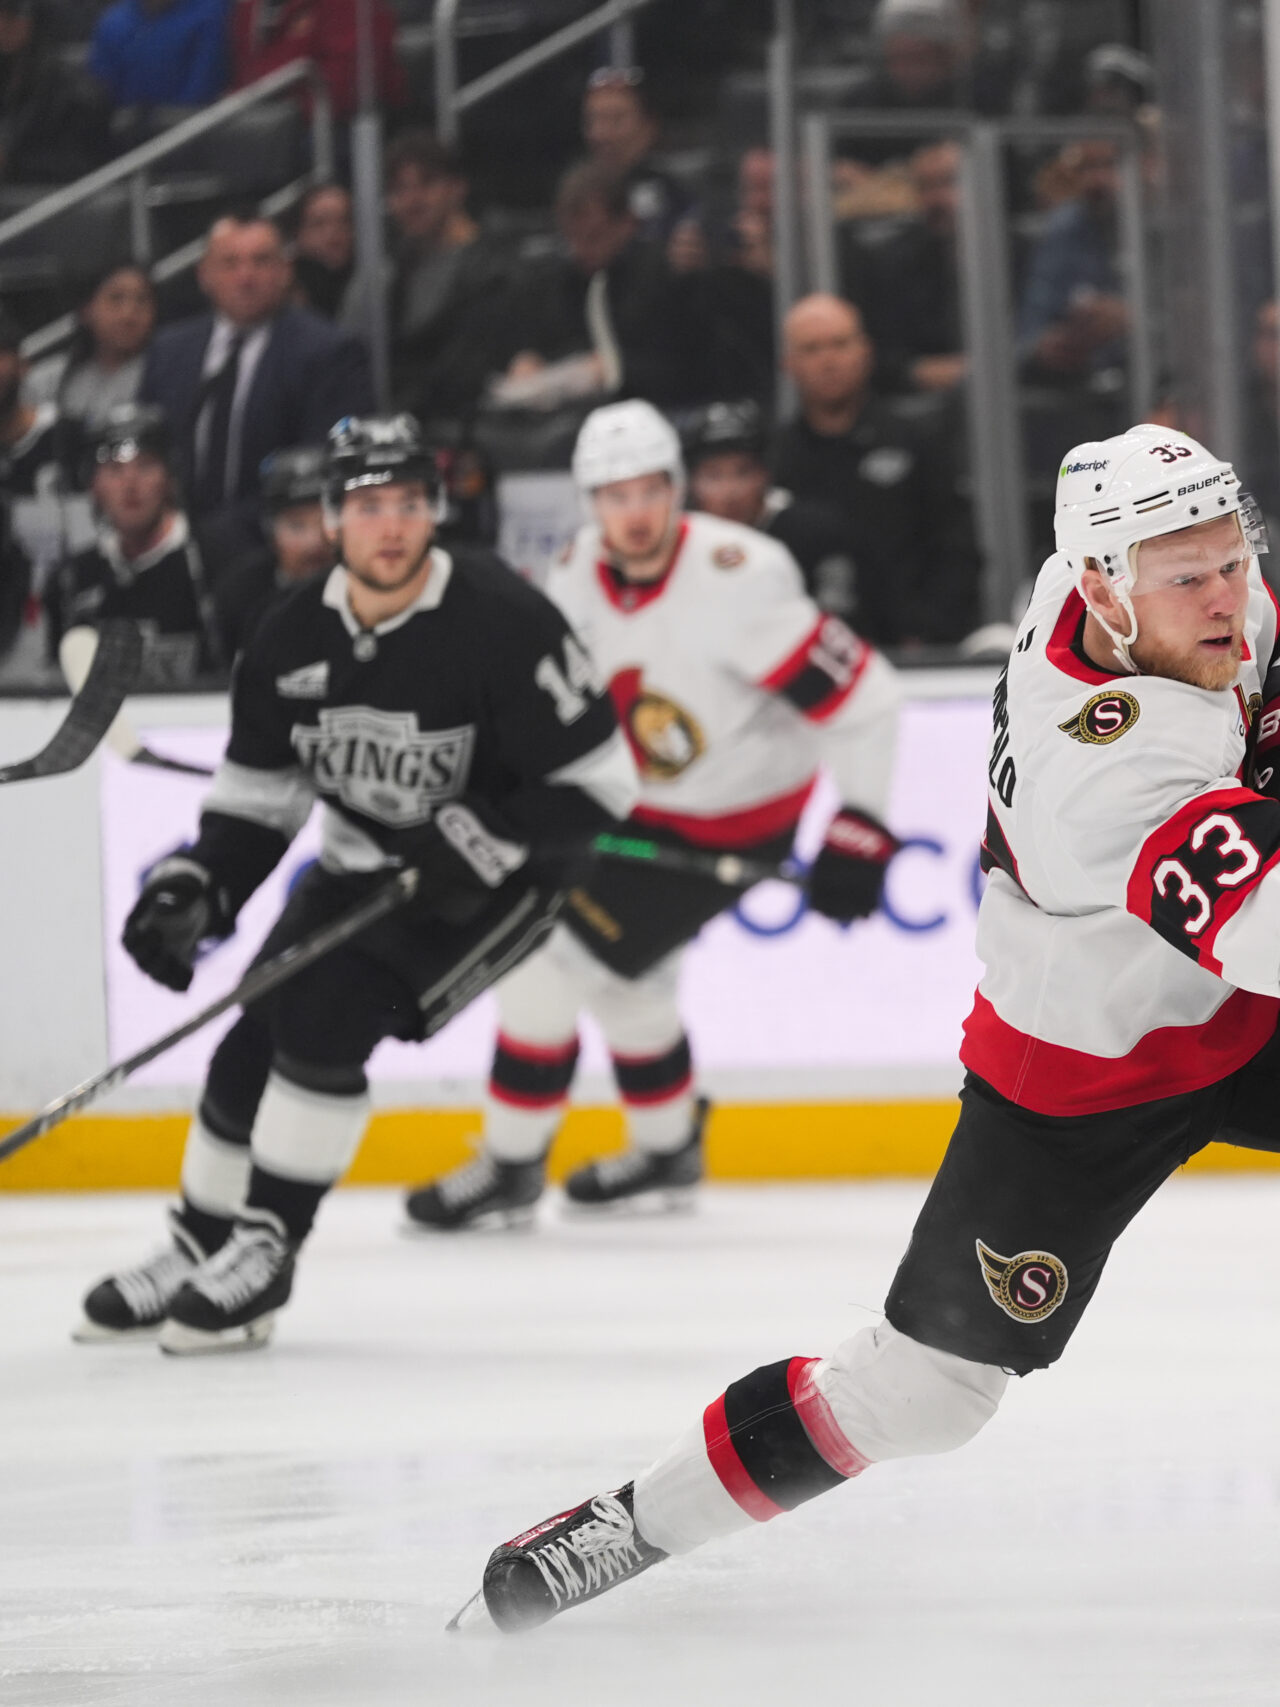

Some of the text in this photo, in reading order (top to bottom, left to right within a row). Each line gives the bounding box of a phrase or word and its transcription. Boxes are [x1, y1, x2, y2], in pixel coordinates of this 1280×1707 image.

[1094, 699, 1123, 735] S
[303, 734, 456, 790] KINGS
[1152, 810, 1263, 936] 33
[1017, 1267, 1052, 1307] S
